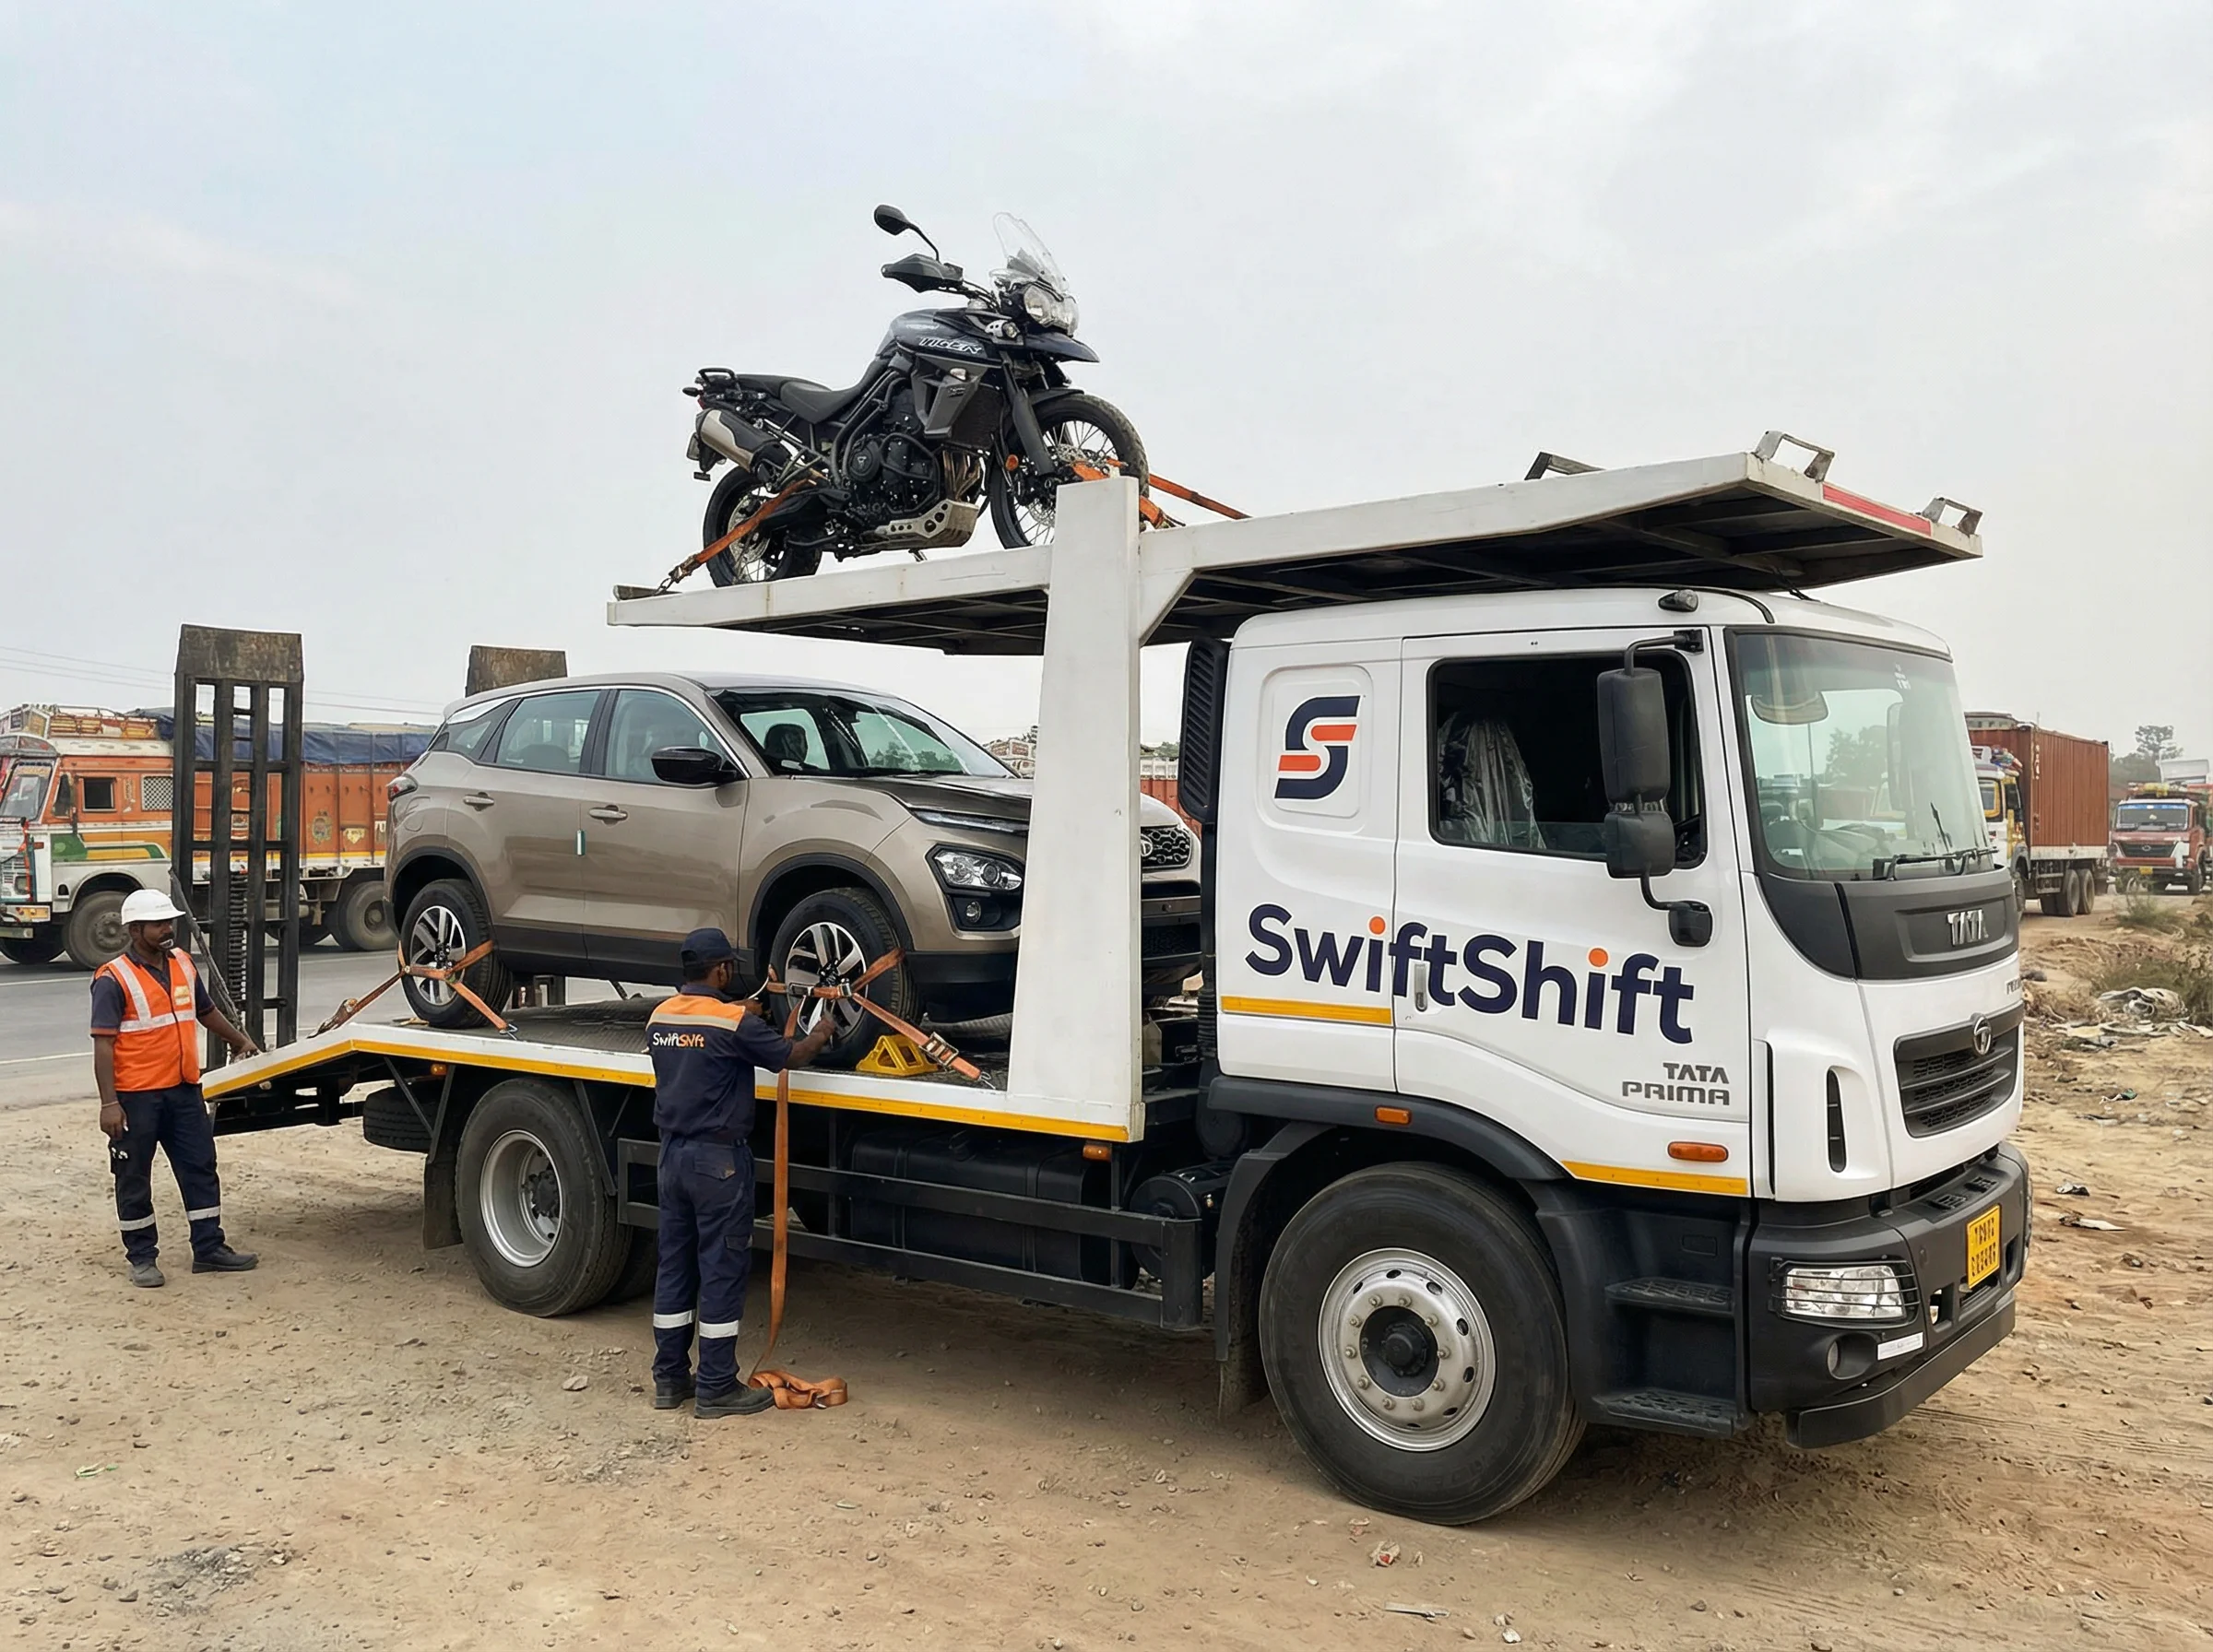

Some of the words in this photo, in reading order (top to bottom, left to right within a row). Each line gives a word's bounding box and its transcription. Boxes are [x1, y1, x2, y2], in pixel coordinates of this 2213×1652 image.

[1245, 903, 1695, 1044] SwiftShift
[1663, 1062, 1730, 1085] TATA
[1622, 1080, 1730, 1105] PRIMA
